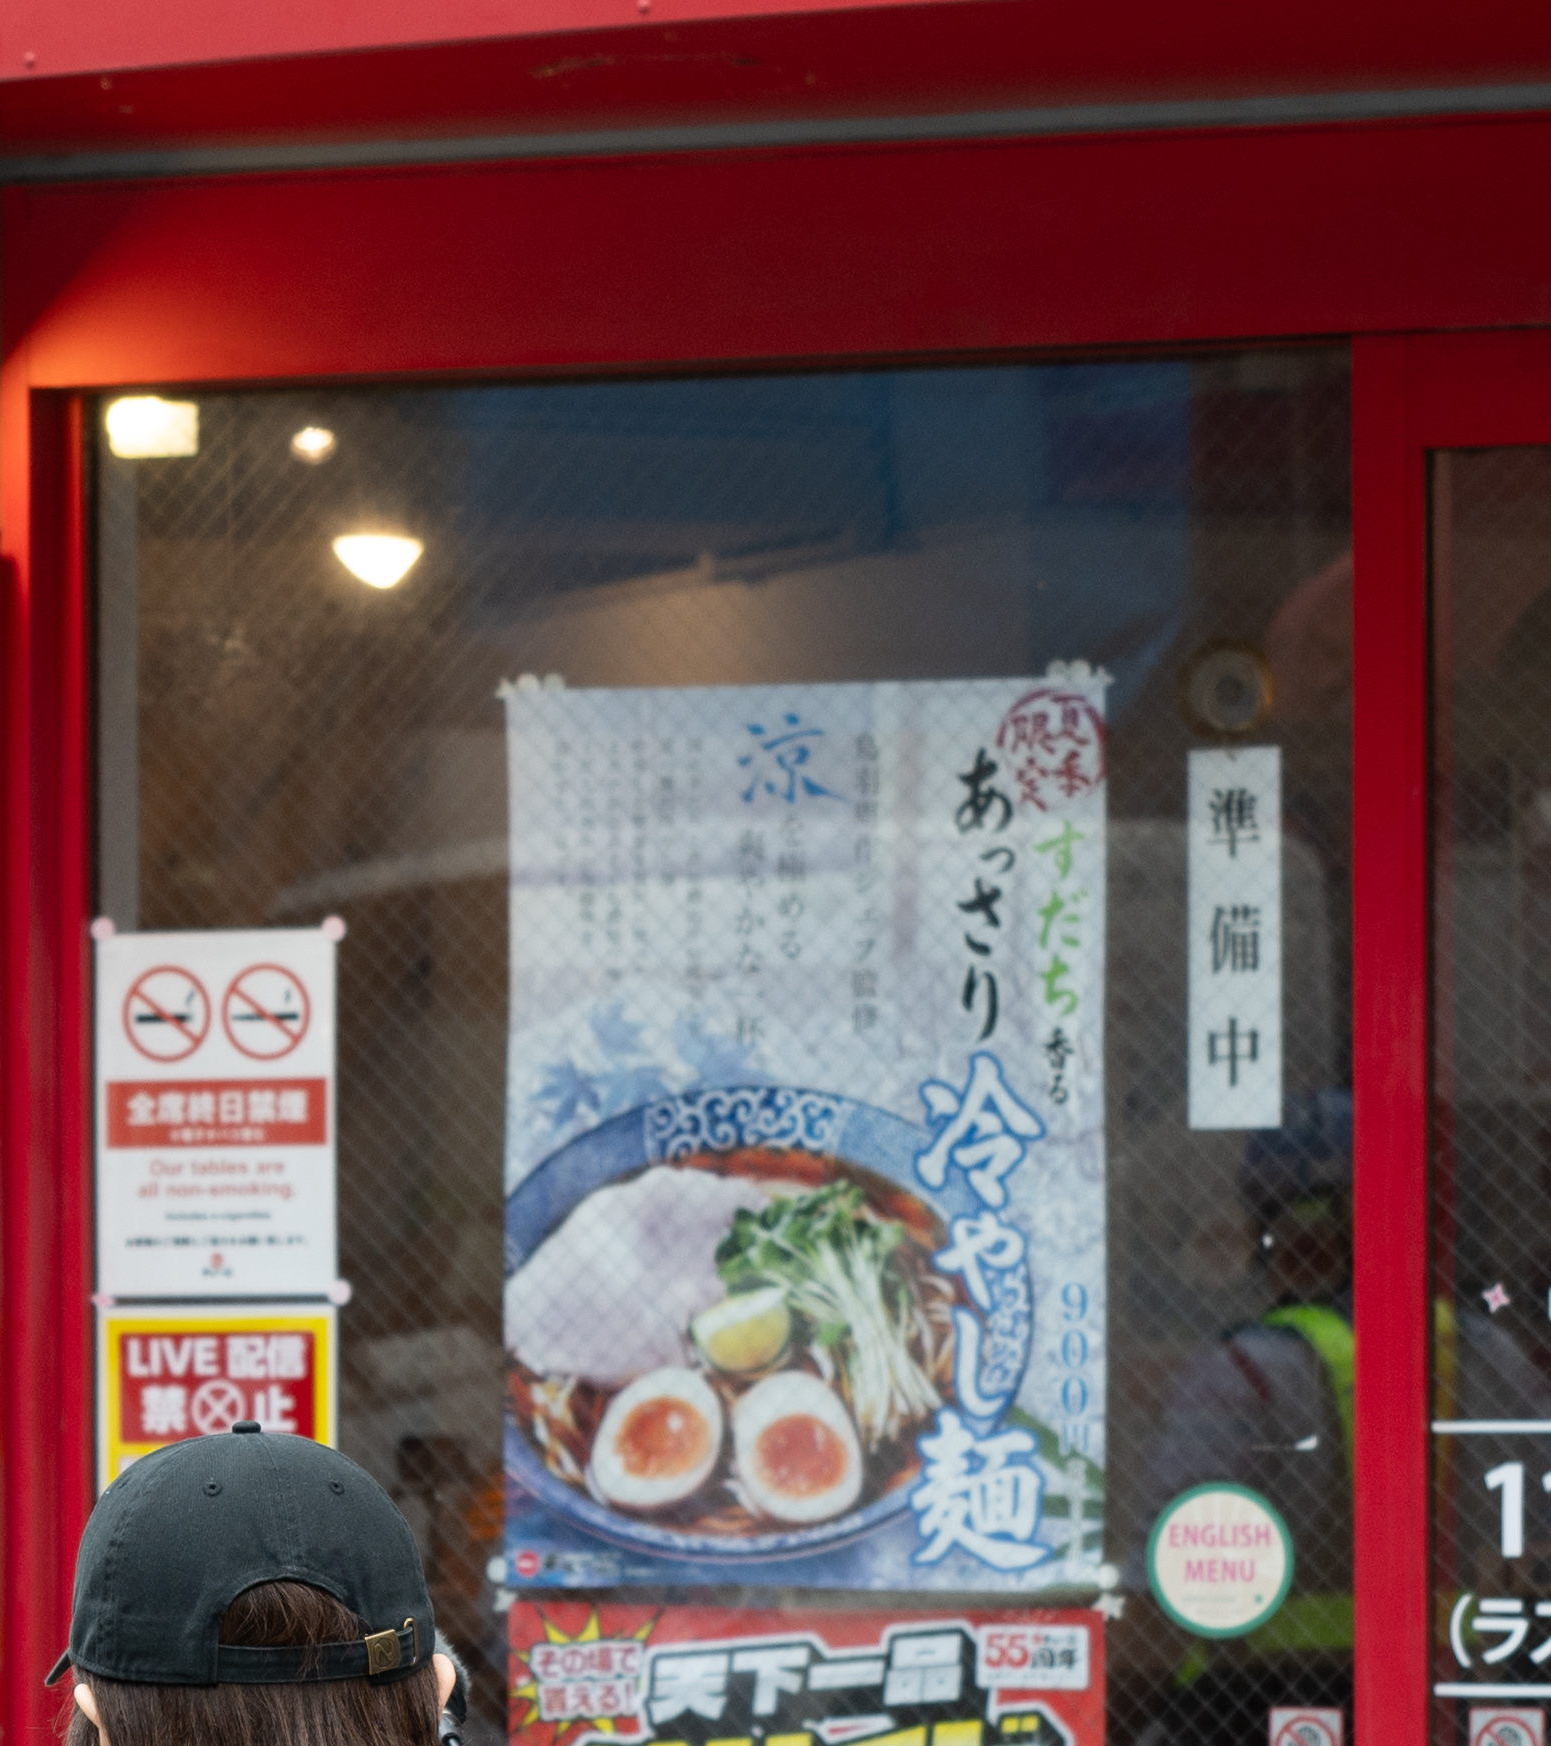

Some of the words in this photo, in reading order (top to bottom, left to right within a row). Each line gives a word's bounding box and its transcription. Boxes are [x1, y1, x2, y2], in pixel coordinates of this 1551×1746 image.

[954, 746, 1016, 1043] あっさり
[1206, 788, 1264, 1090] 準備中
[138, 1182, 159, 1198] all
[149, 1158, 184, 1176] Our
[191, 1159, 248, 1175] tables
[256, 1161, 285, 1174] are
[910, 1051, 1055, 1573] 冷やし麺
[127, 1337, 218, 1377] LIVE
[226, 1334, 306, 1379] 配信
[1169, 1524, 1271, 1549] ENGLISH
[1484, 1461, 1551, 1558] 1
[1184, 1559, 1256, 1584] MENU
[647, 1630, 963, 1725] 天下一品
